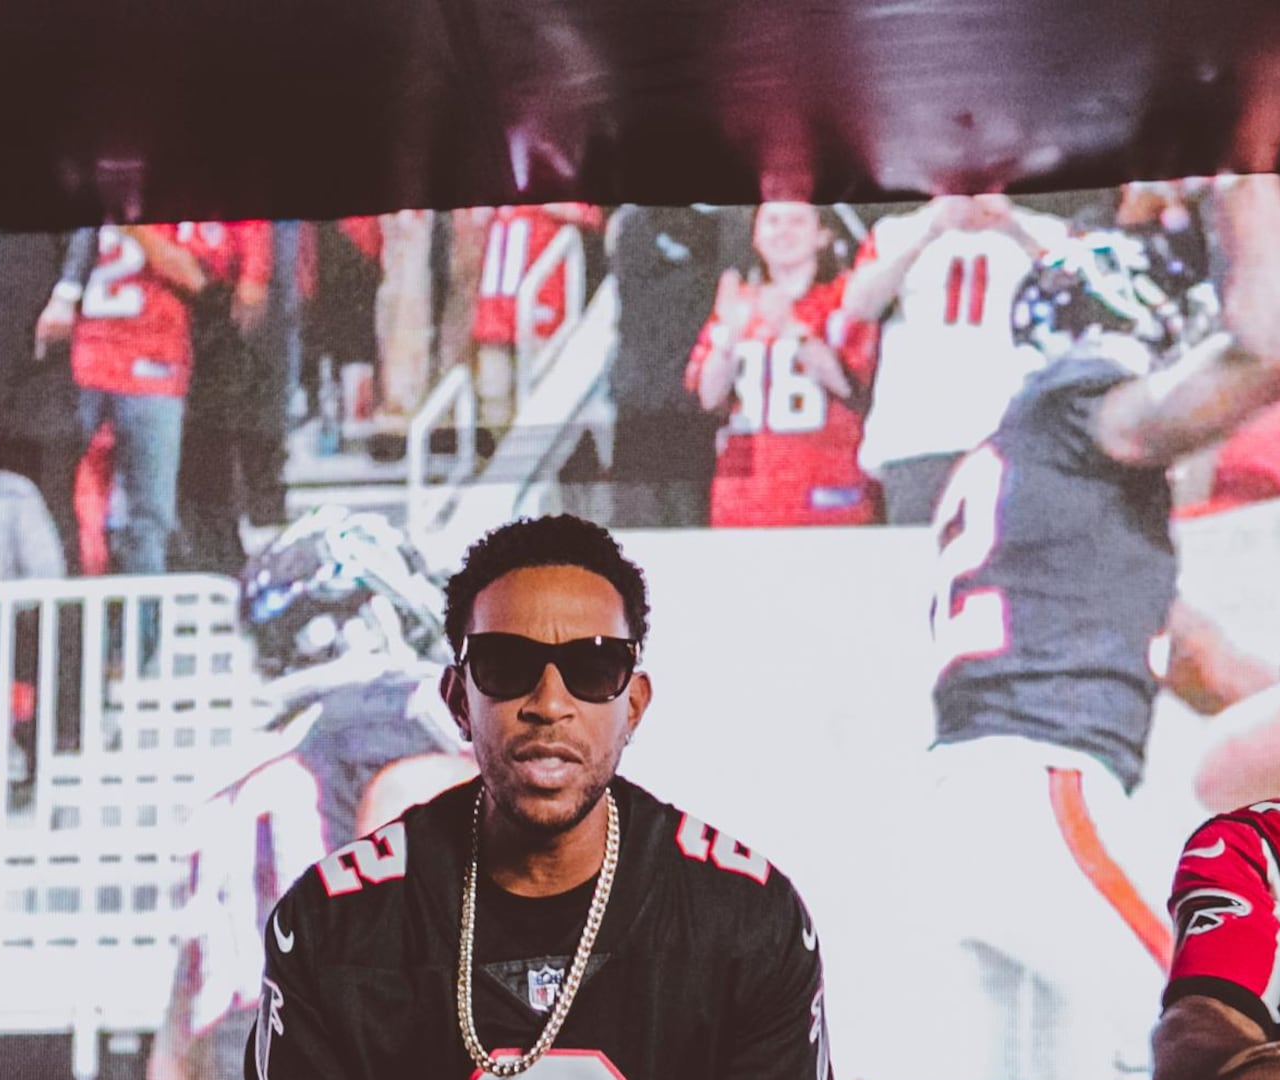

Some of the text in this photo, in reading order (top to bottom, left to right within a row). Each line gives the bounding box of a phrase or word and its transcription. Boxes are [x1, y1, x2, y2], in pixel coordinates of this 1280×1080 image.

[81, 224, 146, 318] 2
[944, 255, 989, 326] 11
[314, 819, 408, 898] 2
